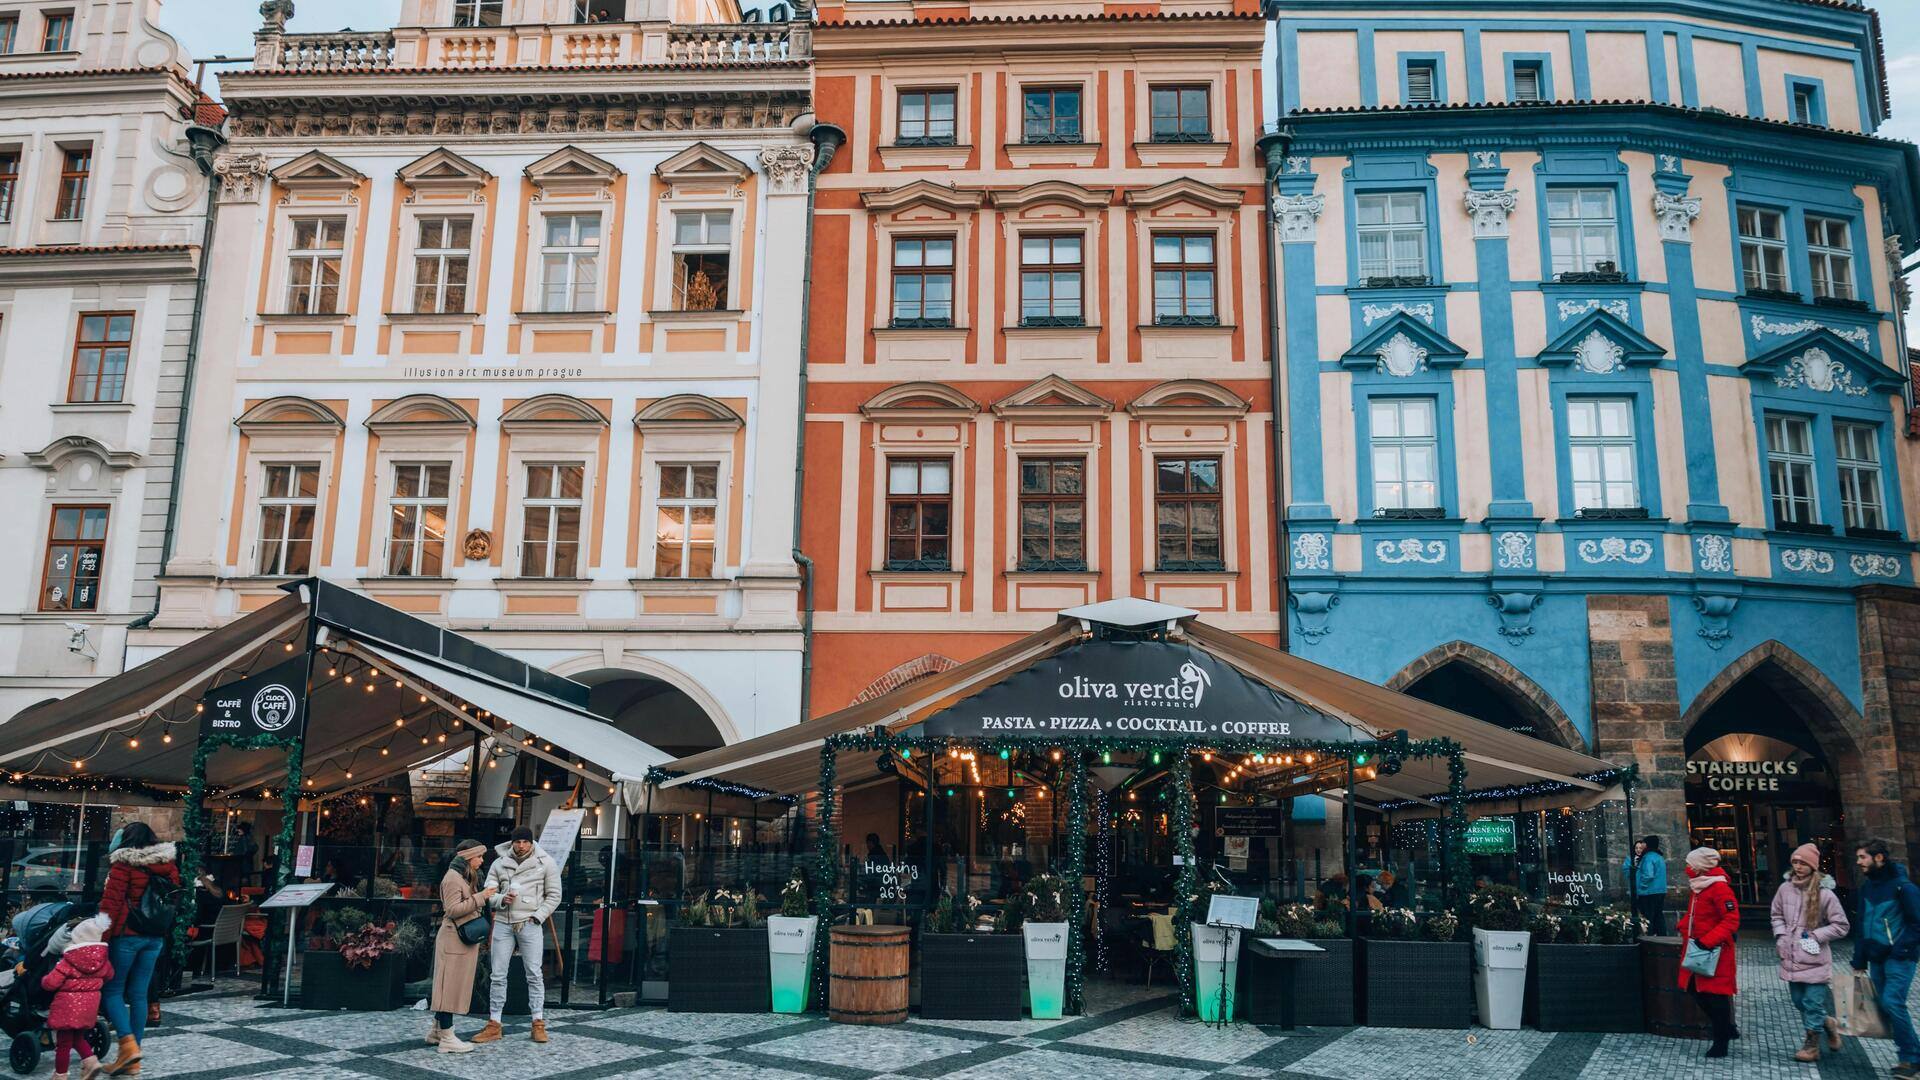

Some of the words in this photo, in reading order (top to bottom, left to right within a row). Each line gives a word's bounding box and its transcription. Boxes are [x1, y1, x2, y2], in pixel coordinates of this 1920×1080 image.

[404, 367, 454, 377] illusion
[458, 368, 477, 377] art
[483, 368, 534, 377] museum
[538, 368, 582, 379] prague
[1058, 675, 1118, 698] oliva
[1124, 677, 1194, 701] verde
[1124, 699, 1195, 708] ristorante
[224, 710, 231, 718] &
[212, 720, 241, 728] BISTRO
[982, 716, 1036, 729] PASTA
[1049, 717, 1102, 730] PIZZA
[1116, 717, 1207, 733] COCKTAIL
[1221, 721, 1291, 735] COFFEE
[1686, 760, 1798, 775] STARBUCKS
[1708, 777, 1780, 791] COFFEE
[864, 861, 919, 880] Heating
[882, 873, 898, 886] On
[1548, 871, 1603, 891] Heating
[1569, 882, 1585, 894] On
